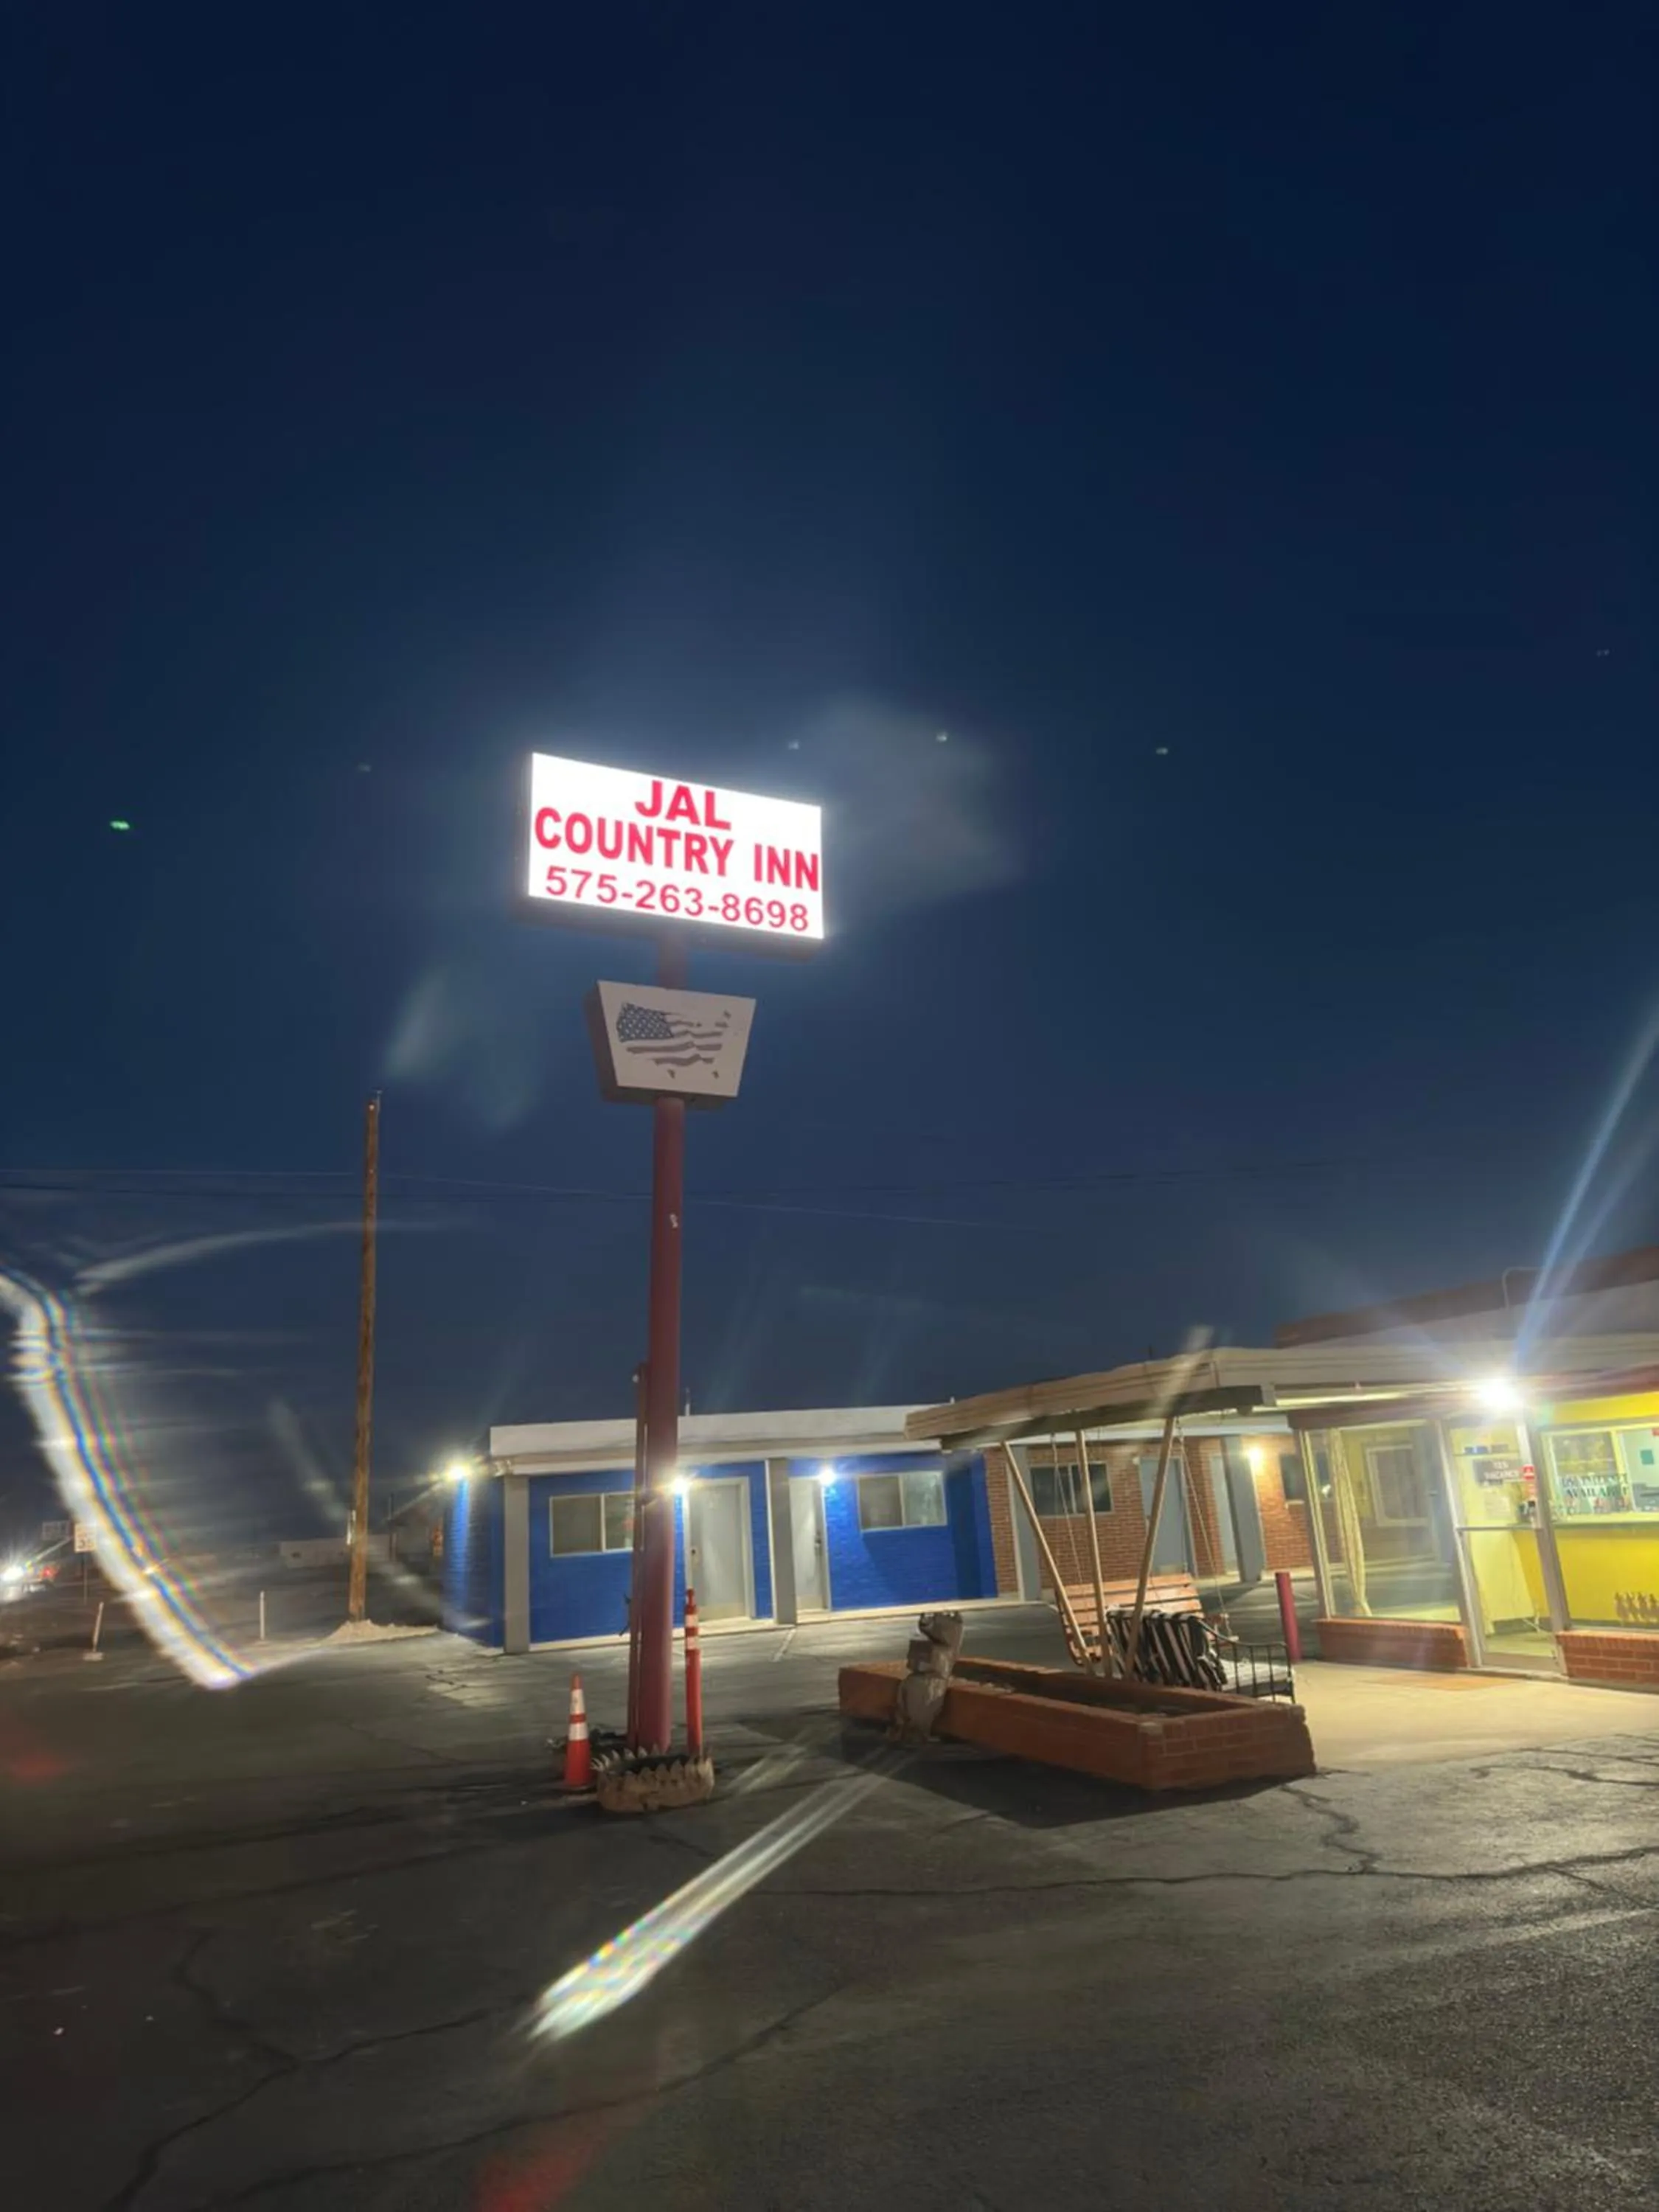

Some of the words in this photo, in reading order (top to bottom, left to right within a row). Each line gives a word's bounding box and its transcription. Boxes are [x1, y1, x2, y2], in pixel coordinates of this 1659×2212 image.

[635, 780, 731, 830] JAL
[535, 807, 734, 877] COUNTRY
[754, 844, 819, 891] INN
[546, 865, 809, 932] 575-263-8698
